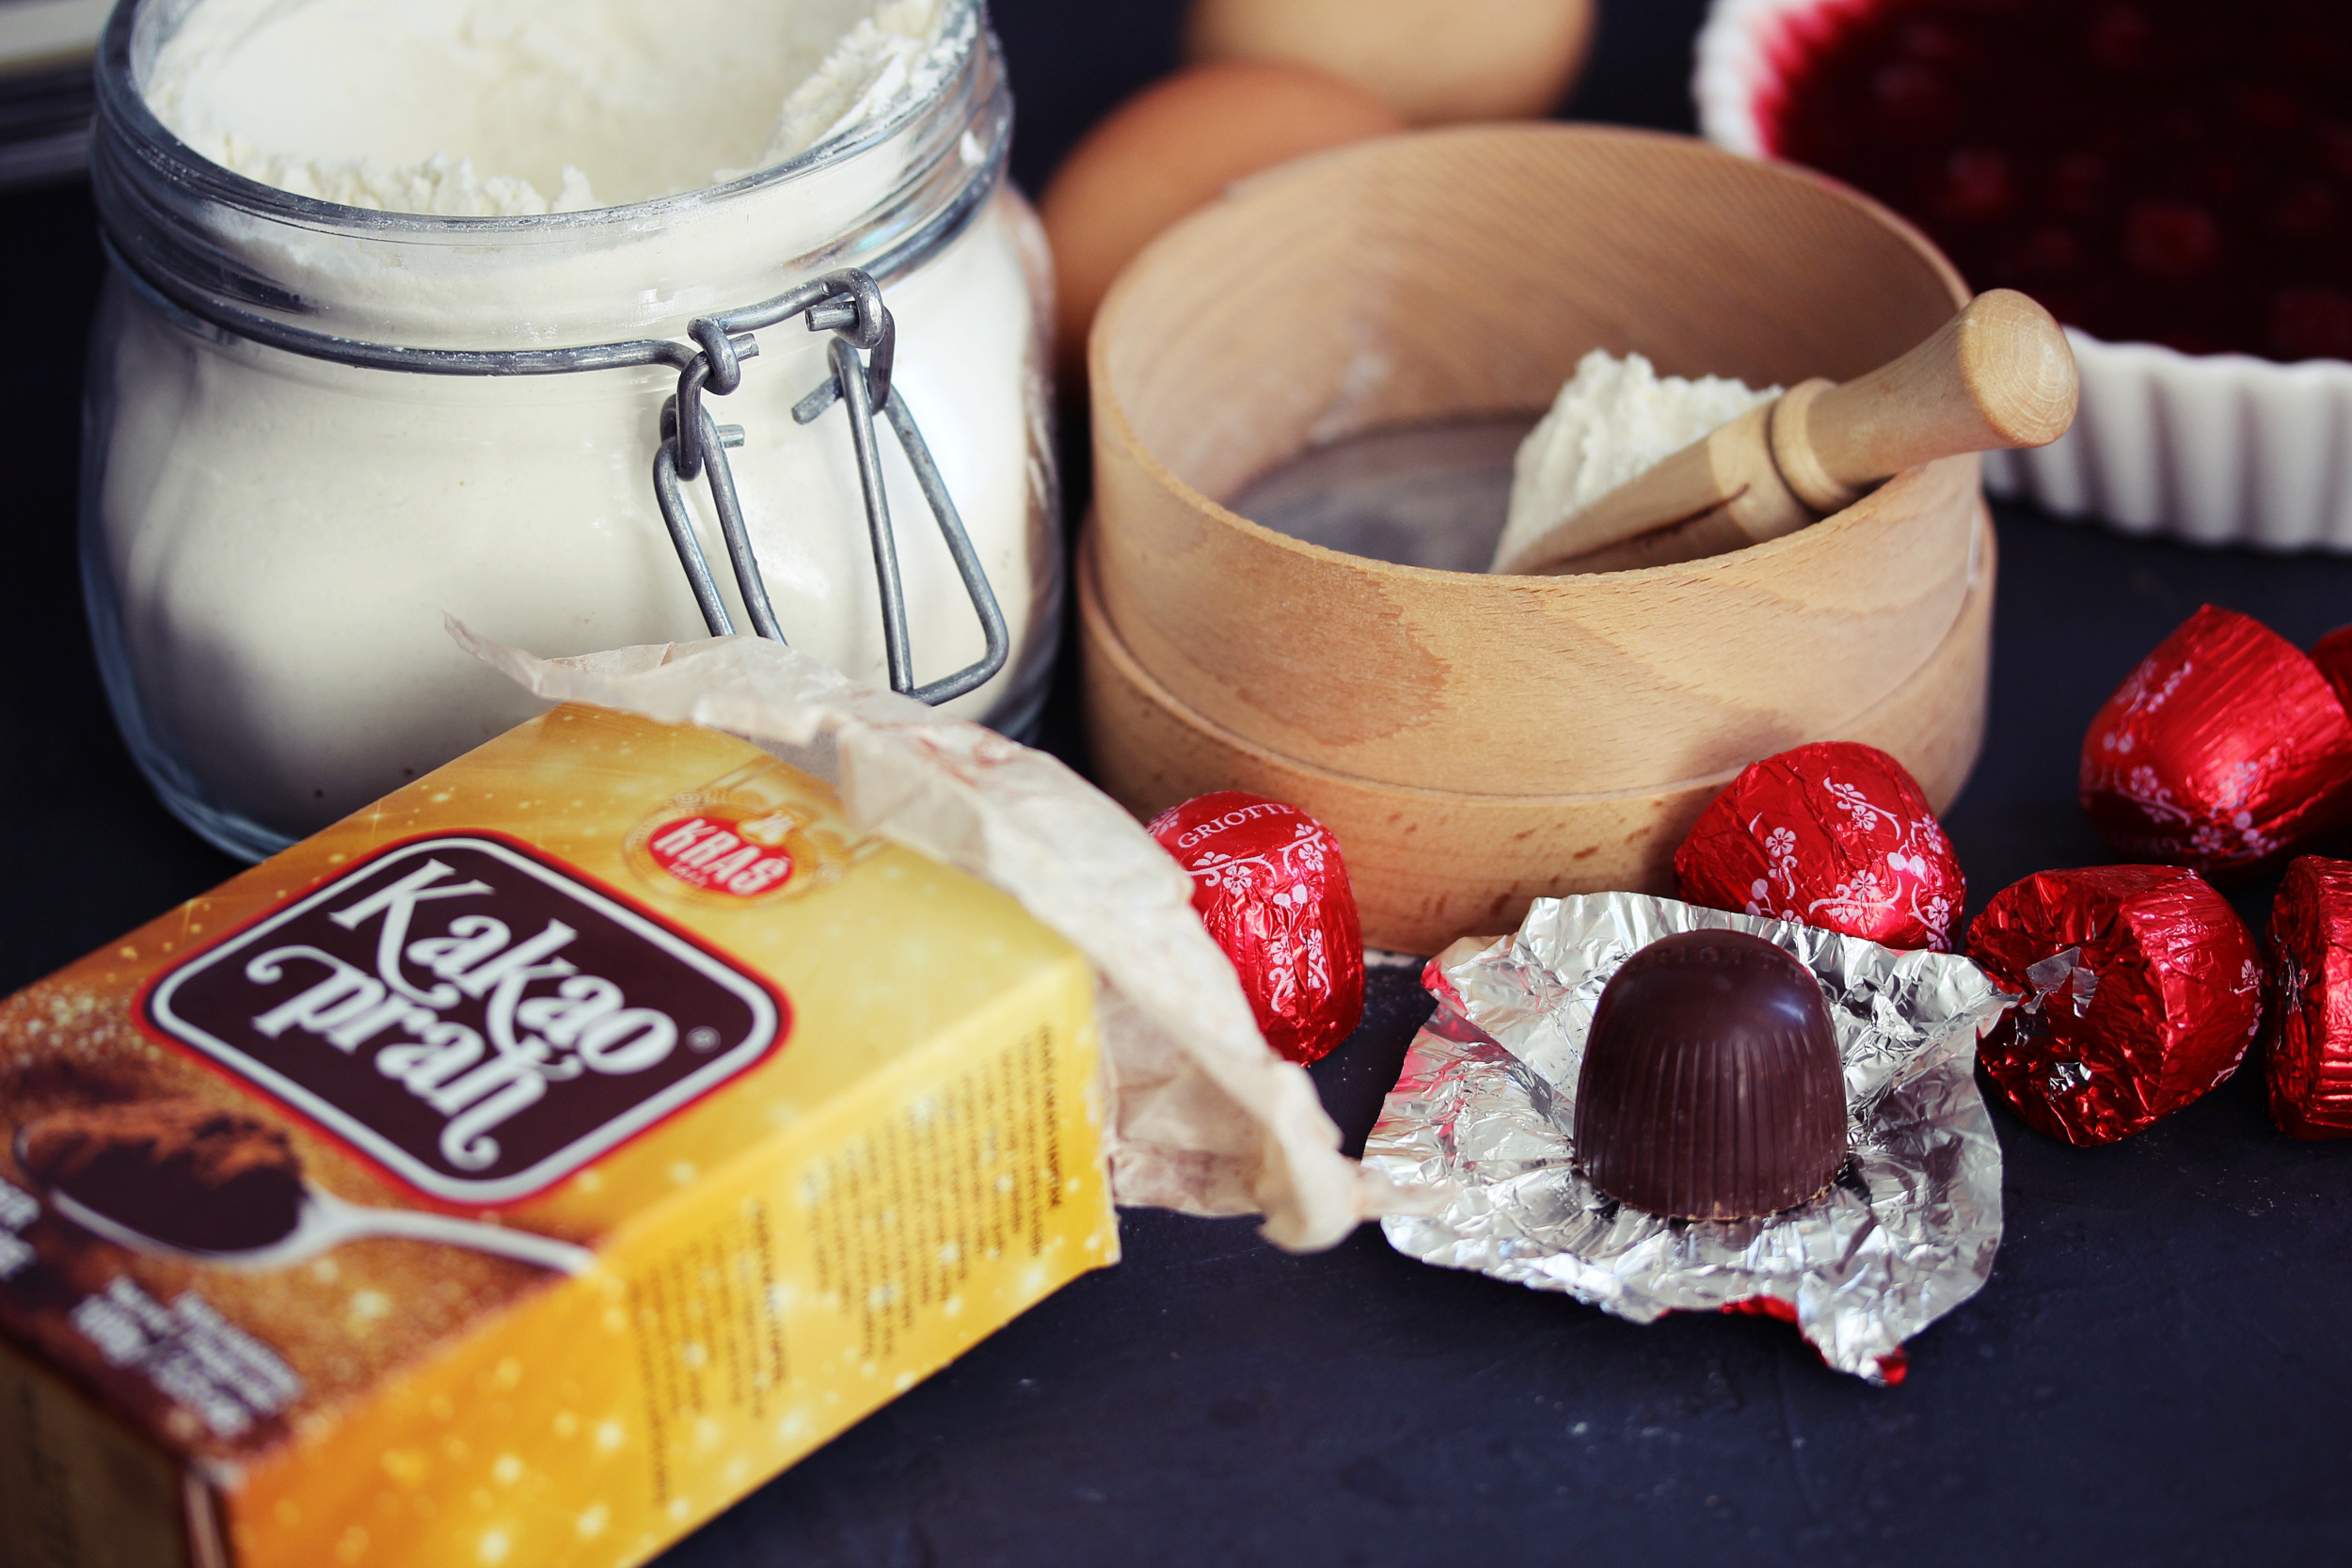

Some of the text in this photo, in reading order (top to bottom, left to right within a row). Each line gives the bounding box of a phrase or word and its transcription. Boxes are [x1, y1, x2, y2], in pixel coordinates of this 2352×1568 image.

[1177, 803, 1295, 848] GRIOTTE
[246, 944, 548, 1171] prah
[328, 858, 678, 1082] Kakao
